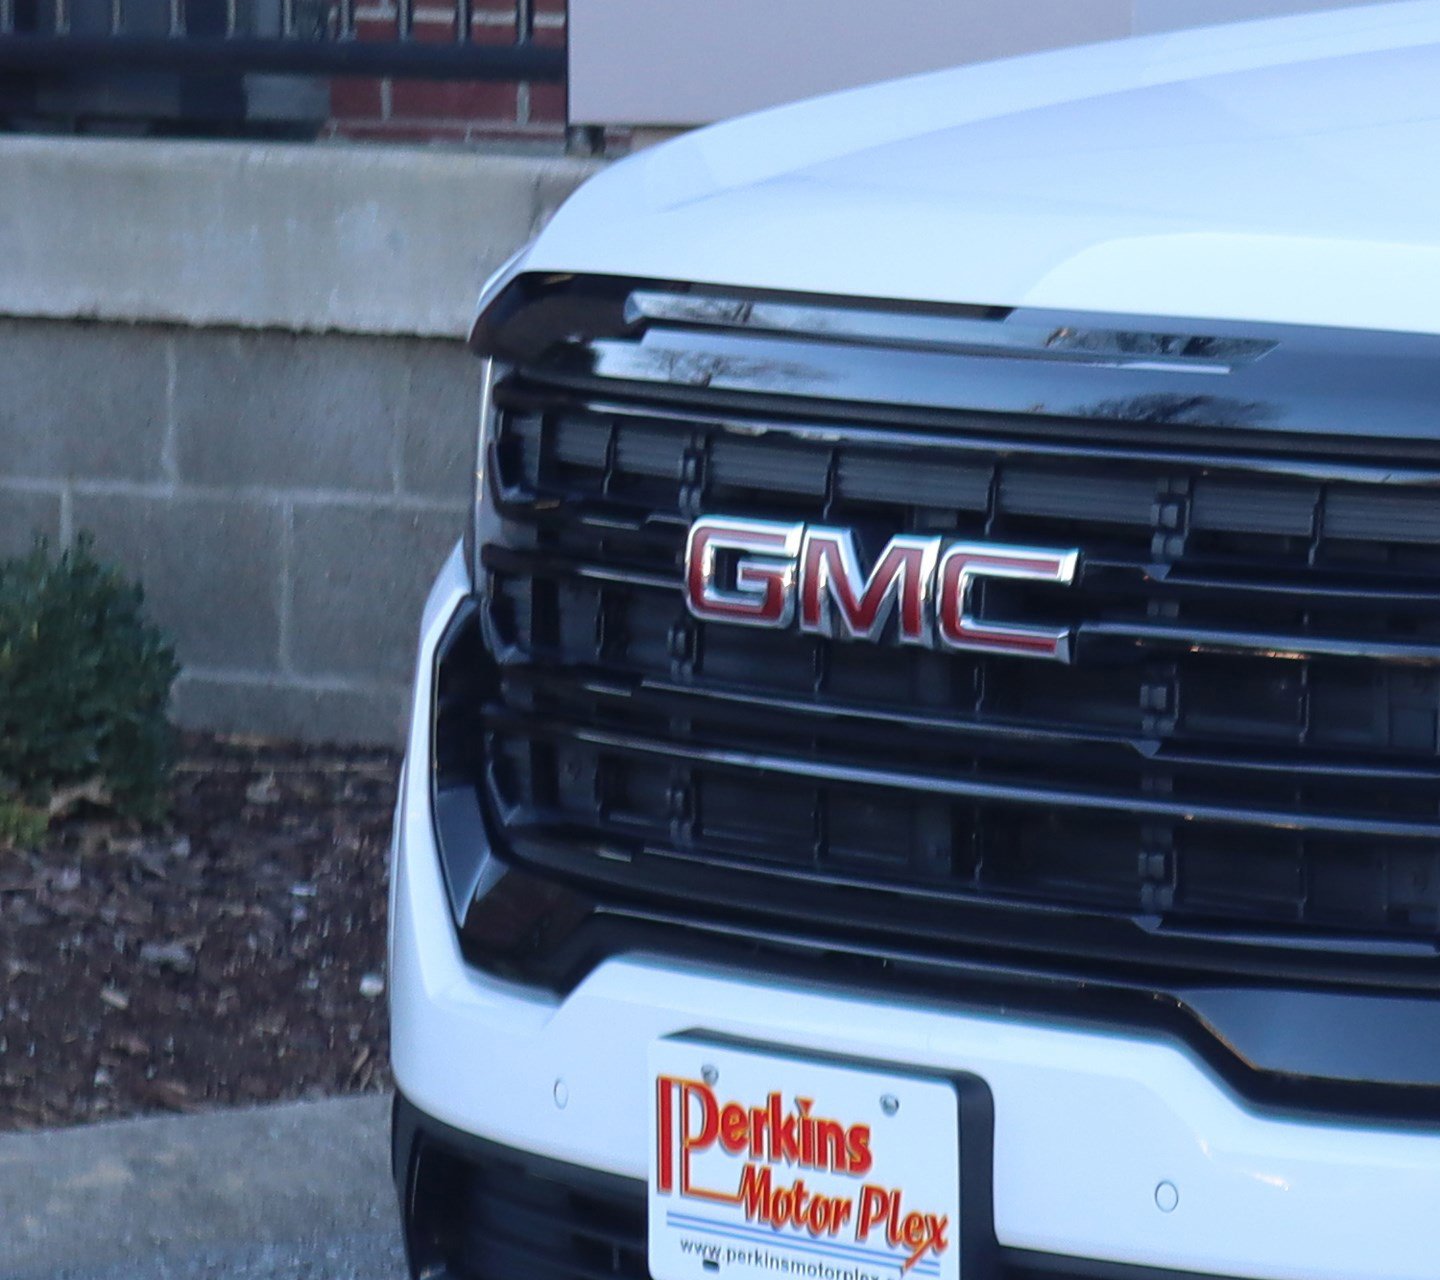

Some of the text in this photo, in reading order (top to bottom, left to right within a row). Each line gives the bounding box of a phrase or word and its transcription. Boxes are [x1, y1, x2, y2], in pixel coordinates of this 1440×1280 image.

[684, 513, 1081, 666] GMC
[656, 1074, 875, 1195] Perkins
[740, 1163, 950, 1276] Motor Plex
